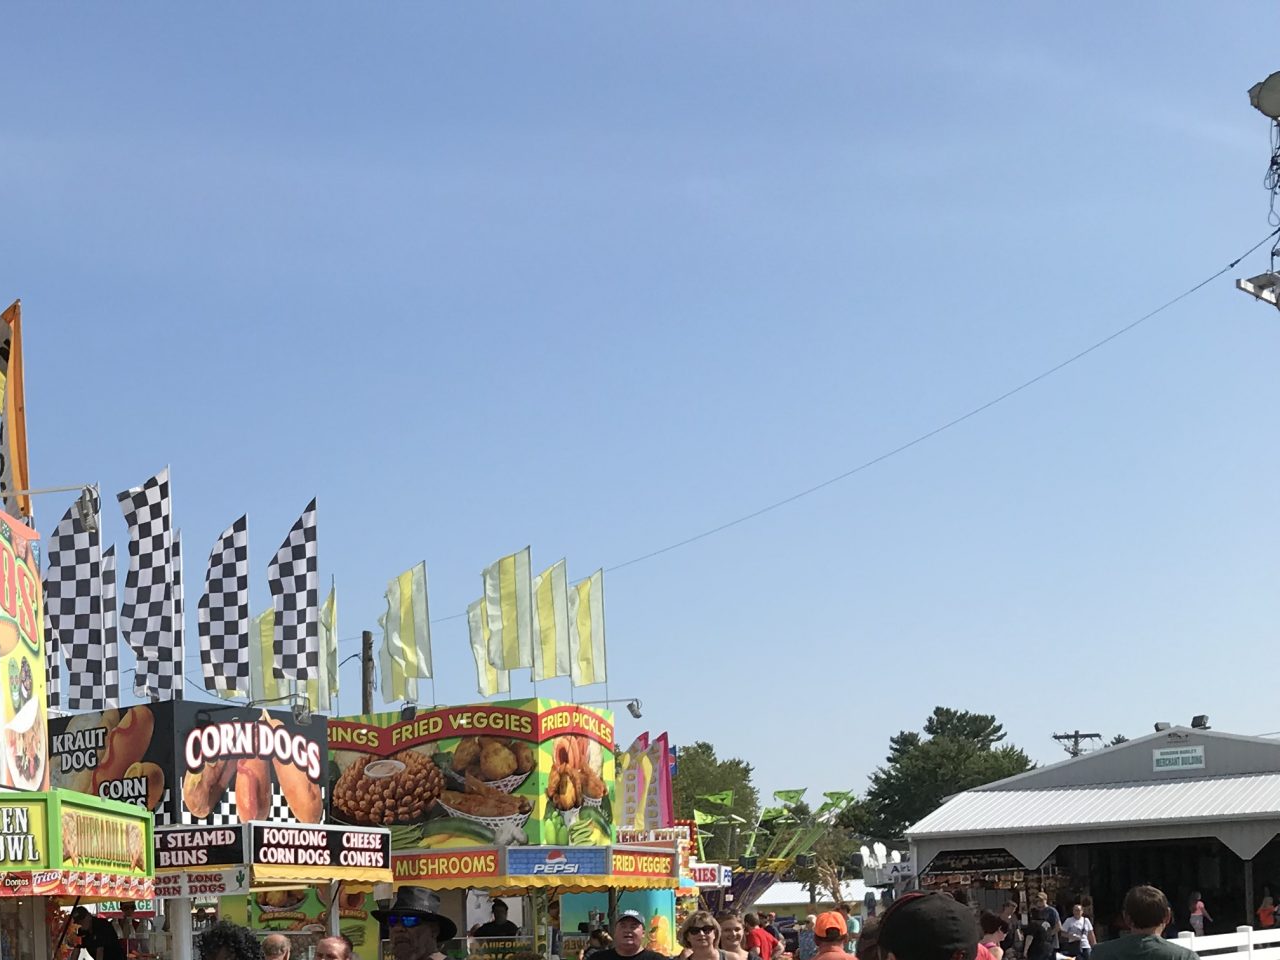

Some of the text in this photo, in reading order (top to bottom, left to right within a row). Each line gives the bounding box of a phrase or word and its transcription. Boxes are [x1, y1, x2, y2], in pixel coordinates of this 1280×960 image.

[327, 711, 533, 748] RINGS FRIED VEGGIES
[542, 712, 613, 745] FRIED PICKLES
[52, 728, 107, 754] KRAUT
[184, 720, 321, 780] CORN DOGS
[61, 750, 97, 772] DOG
[98, 776, 147, 801] CORN
[167, 829, 236, 849] STEAMED
[262, 828, 328, 847] FOOTLONG
[342, 831, 382, 850] CHEESE
[159, 849, 208, 866] BUNS
[259, 848, 331, 866] CORN DOGS
[339, 849, 384, 868] CONEYS
[394, 853, 496, 878] MUSHROOMS
[612, 854, 671, 874] FRIED VEGGIES
[533, 862, 580, 875] PEPSI
[688, 867, 717, 883] RIES
[5, 878, 29, 887] Doritos
[154, 875, 180, 885] OOT
[187, 873, 223, 885] LONG
[154, 884, 226, 897] ORN DOGS
